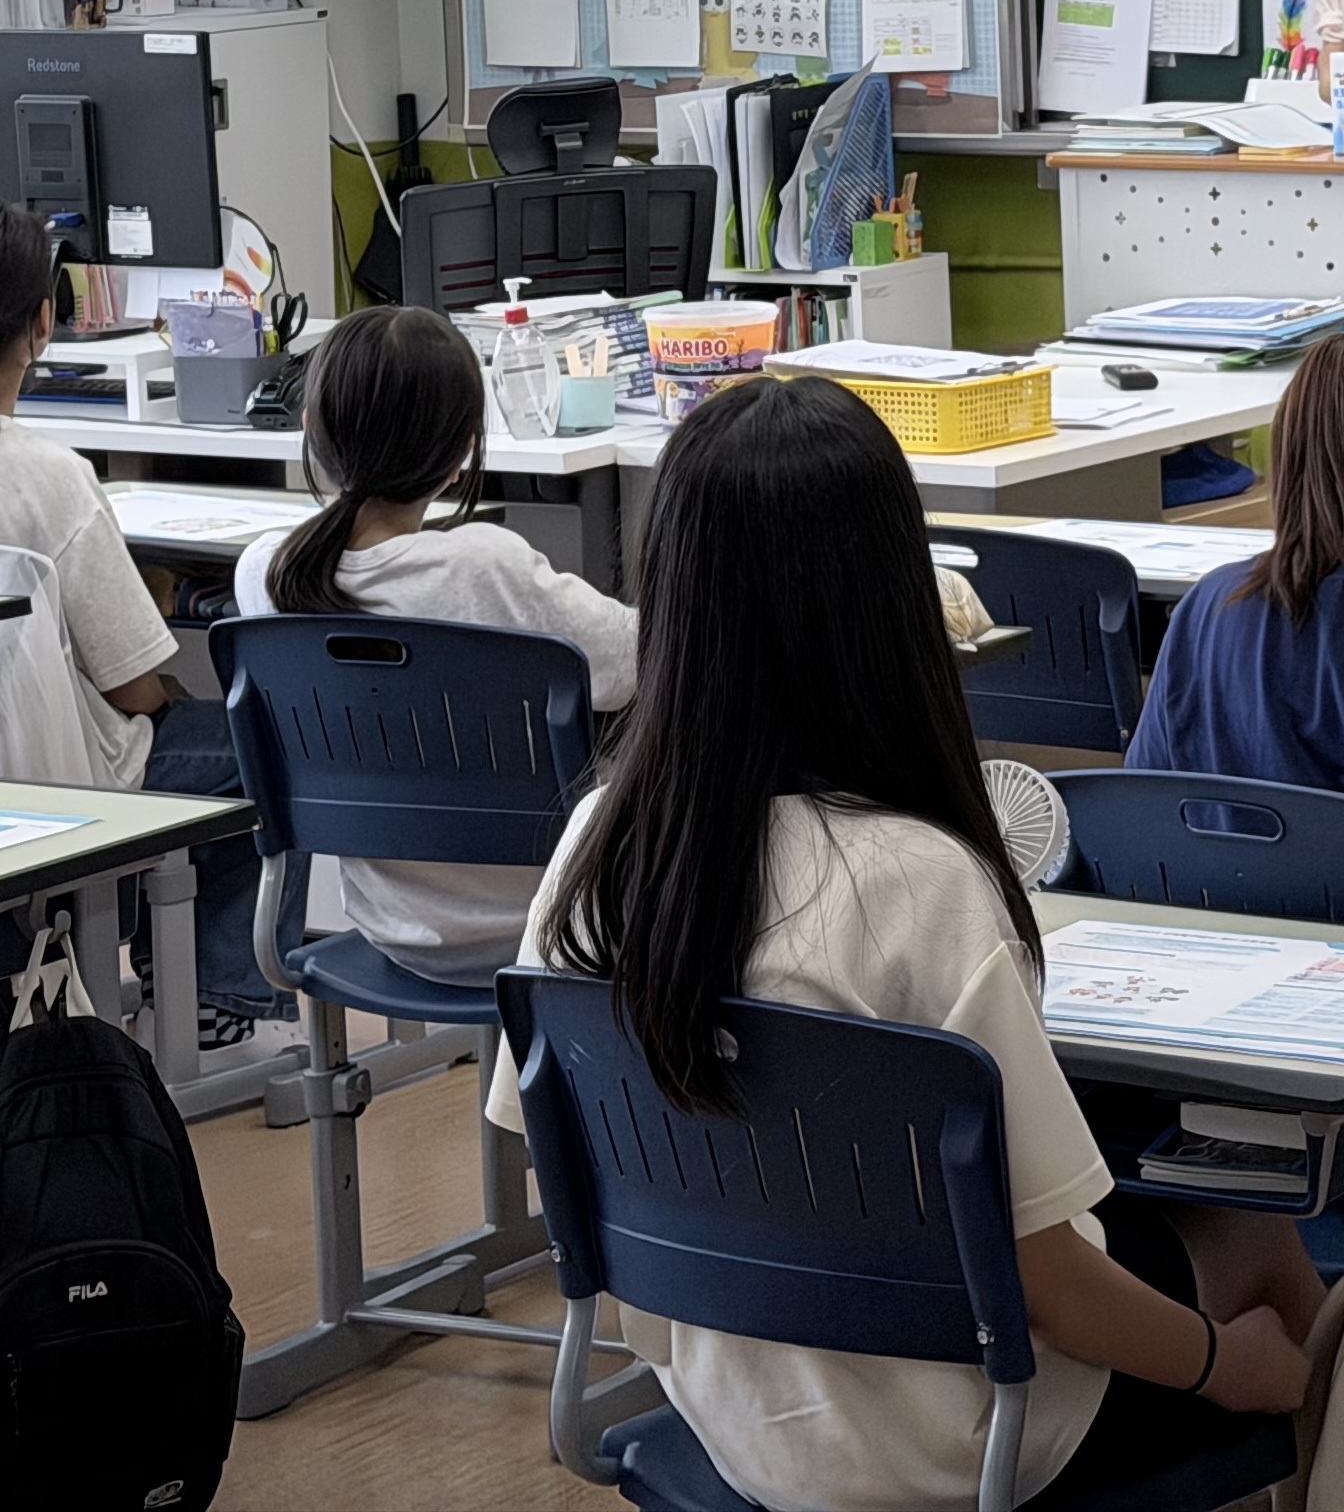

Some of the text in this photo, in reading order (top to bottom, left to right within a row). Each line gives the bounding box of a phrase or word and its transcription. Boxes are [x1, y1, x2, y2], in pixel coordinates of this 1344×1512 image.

[27, 58, 81, 73] Redstone
[660, 339, 728, 357] HARIBO
[68, 1281, 108, 1303] FILA
